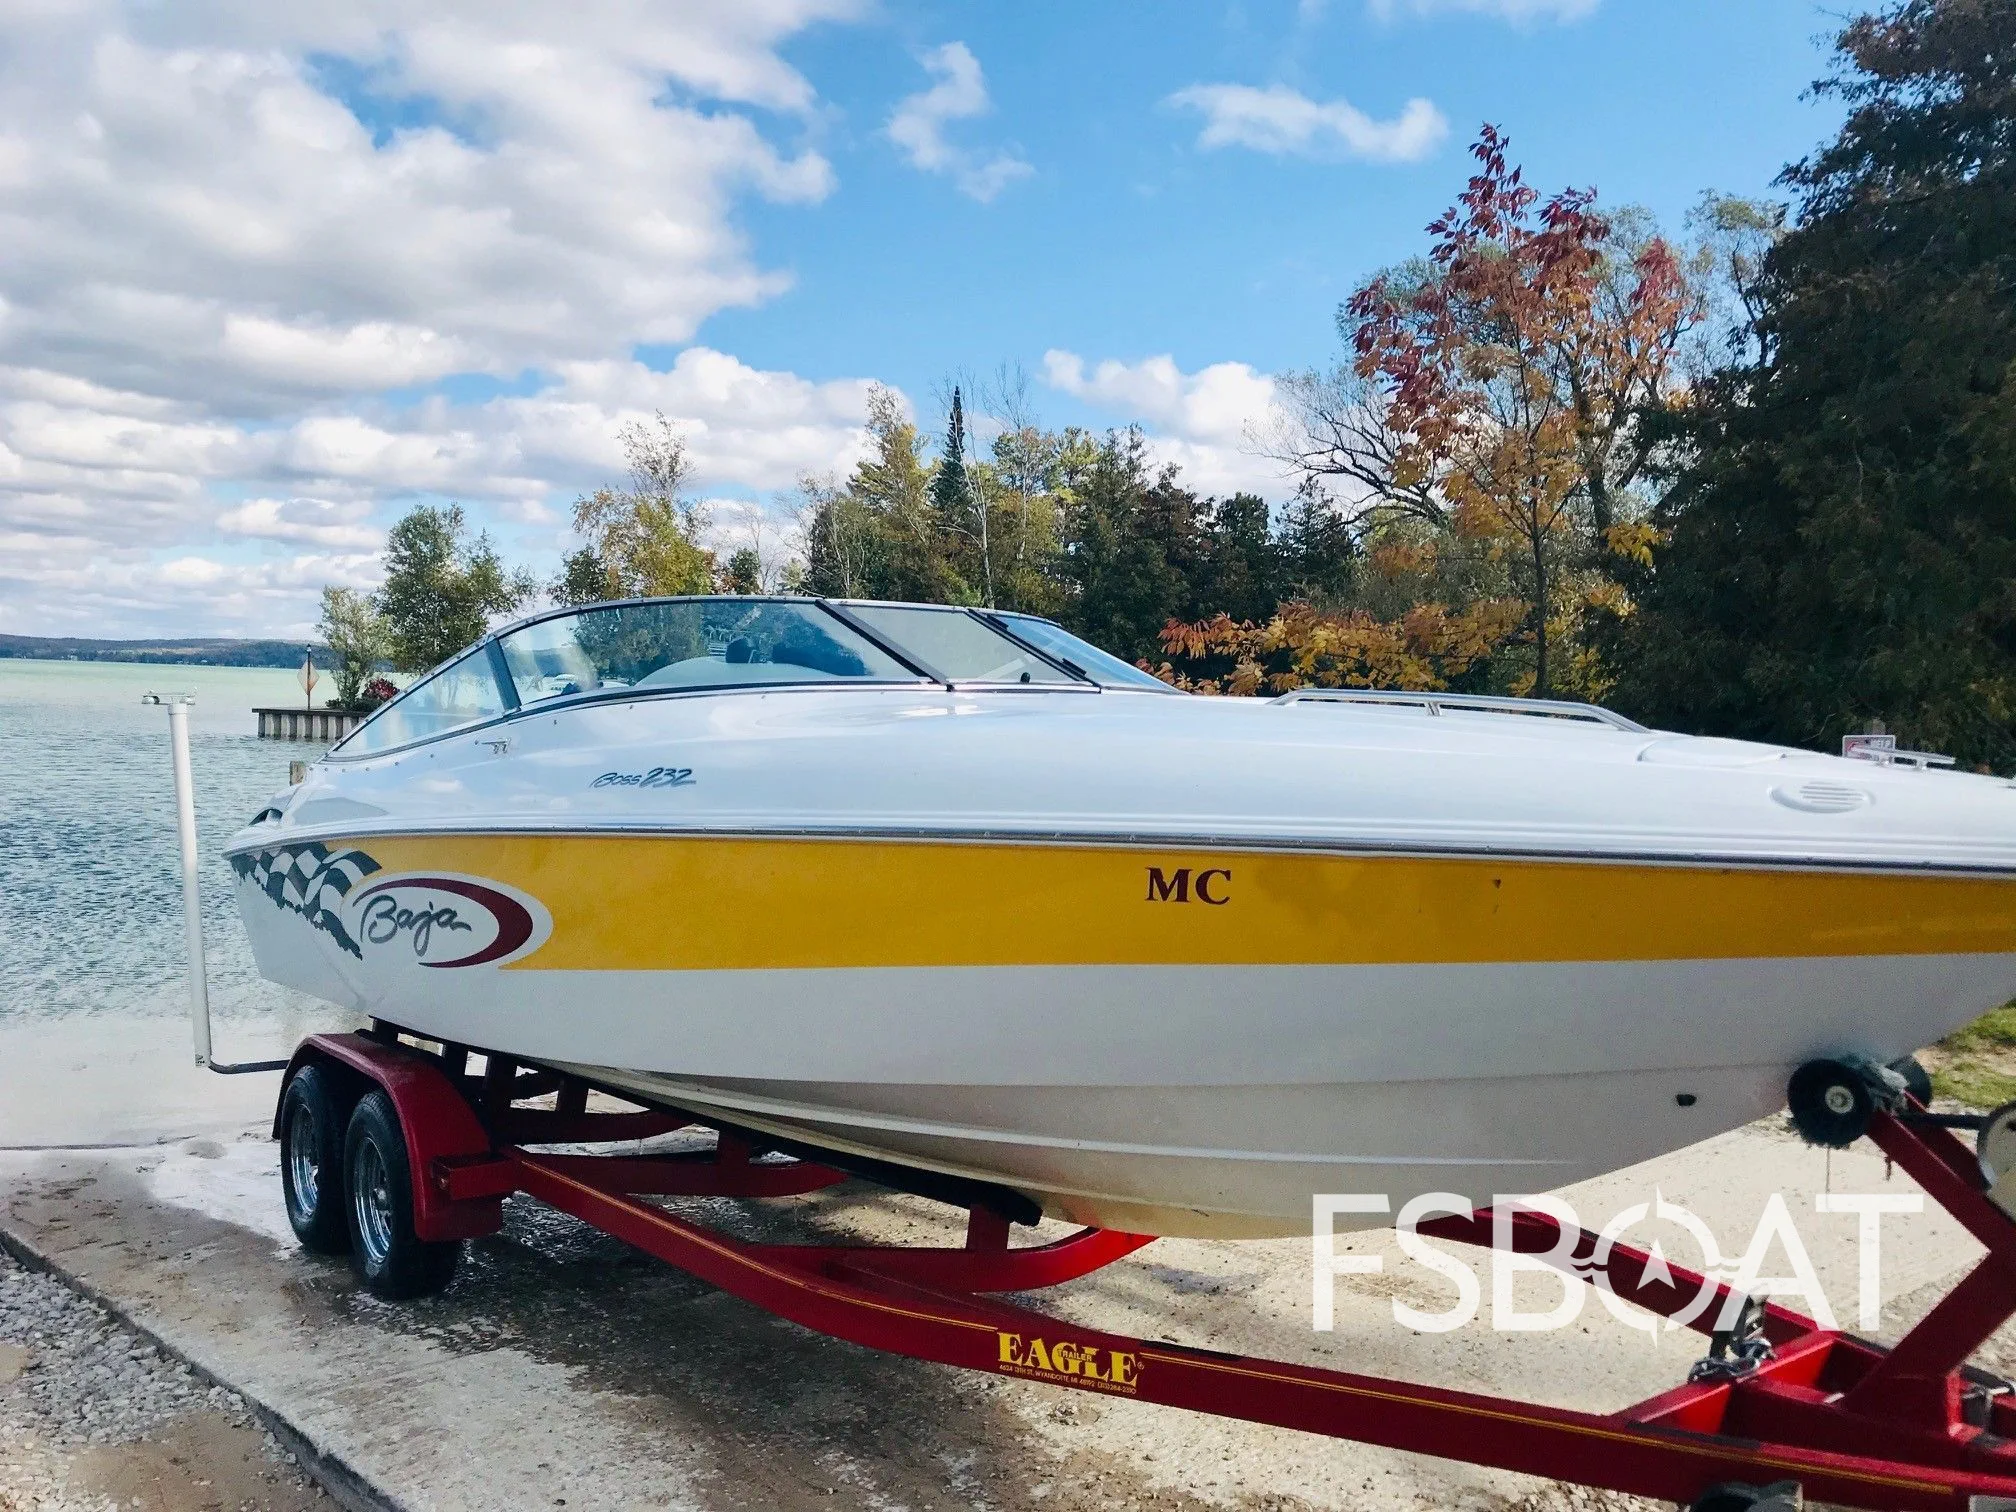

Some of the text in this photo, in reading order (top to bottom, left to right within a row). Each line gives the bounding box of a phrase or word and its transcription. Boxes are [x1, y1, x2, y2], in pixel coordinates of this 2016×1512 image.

[639, 767, 697, 788] 232
[1145, 867, 1231, 905] MC
[360, 894, 472, 957] Baja
[997, 1332, 1138, 1387] EAGLE
[1057, 1349, 1093, 1362] TRAILER
